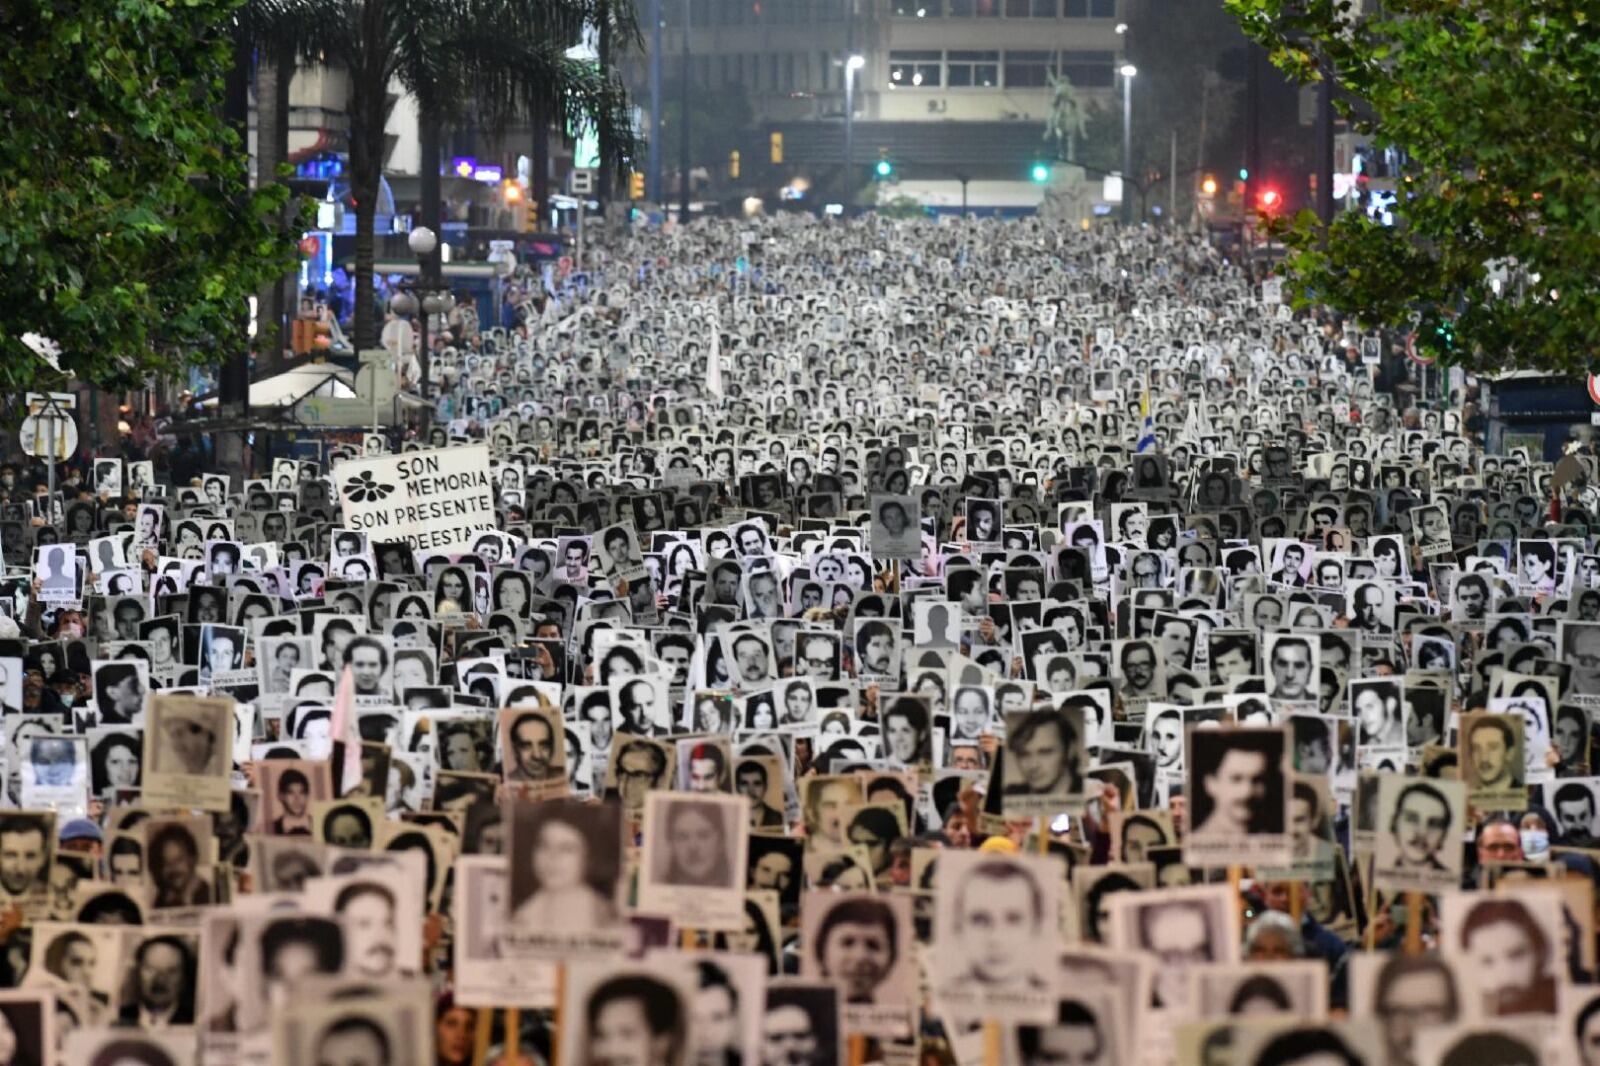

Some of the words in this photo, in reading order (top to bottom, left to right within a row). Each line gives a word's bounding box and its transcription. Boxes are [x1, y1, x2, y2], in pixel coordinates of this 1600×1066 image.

[397, 455, 440, 480] SON
[406, 470, 489, 498] MEMORIA
[350, 508, 389, 530] SON
[395, 495, 491, 525] PRESENTE
